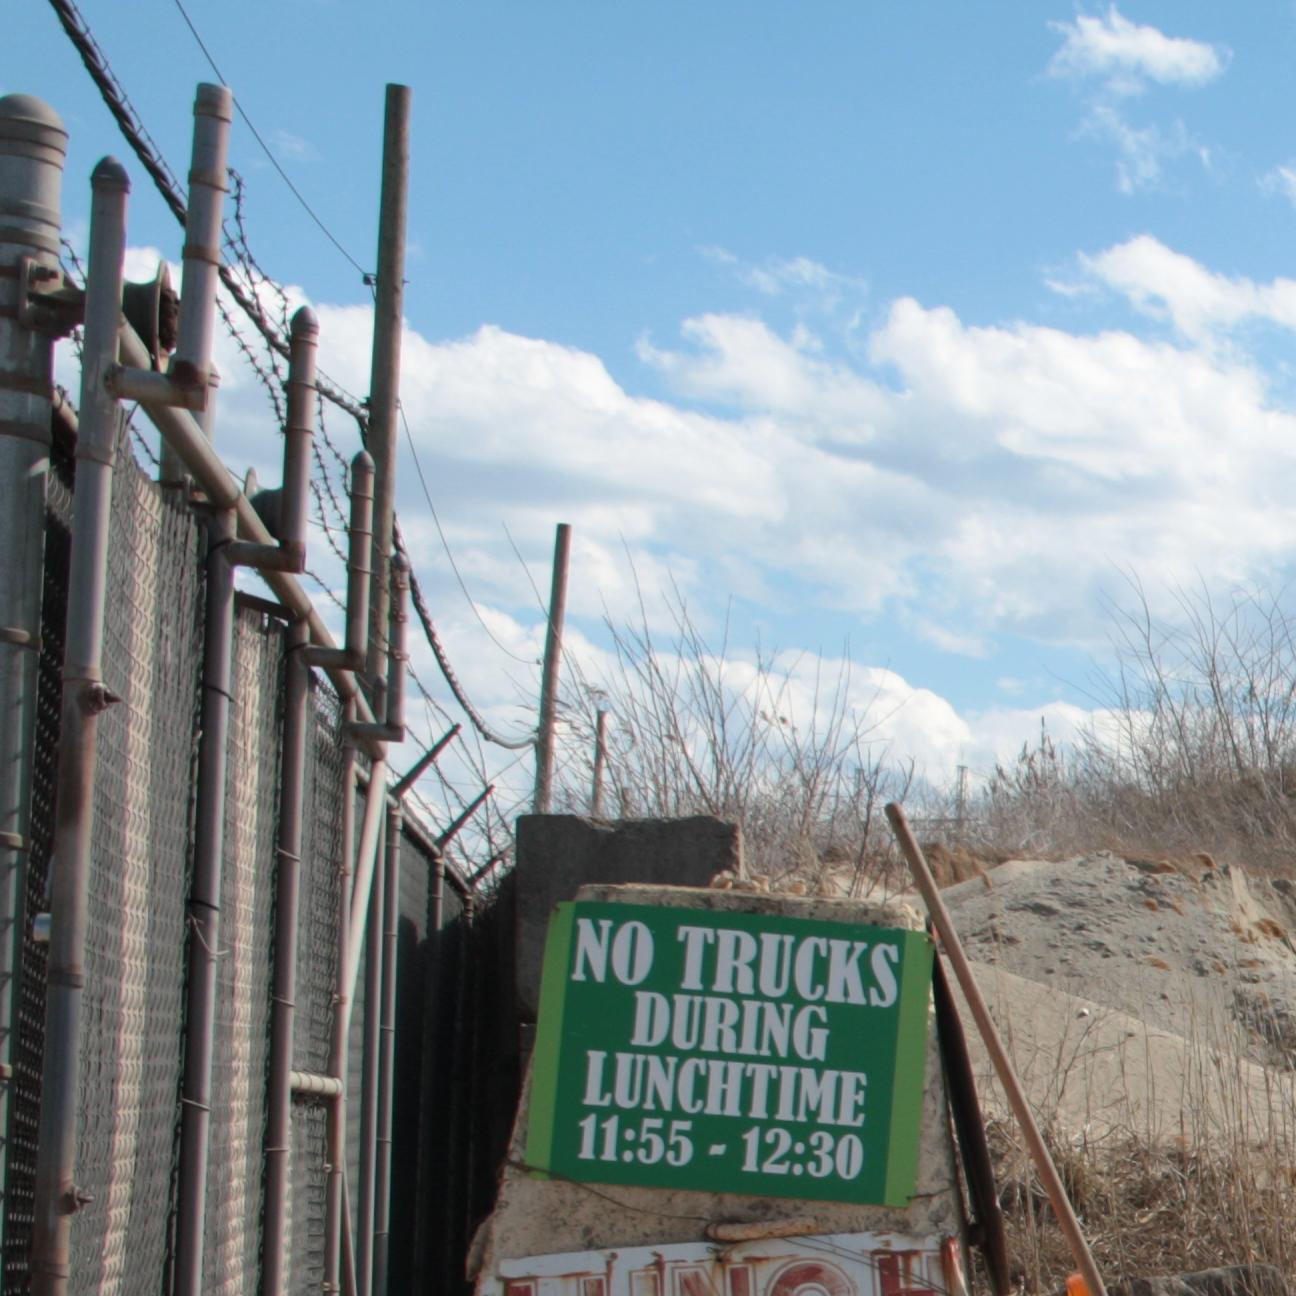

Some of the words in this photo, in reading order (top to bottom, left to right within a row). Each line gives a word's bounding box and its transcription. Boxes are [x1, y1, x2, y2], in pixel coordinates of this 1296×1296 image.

[571, 918, 654, 986] NO
[677, 925, 898, 1008] TRUCKS
[630, 991, 830, 1062] DURING
[583, 1051, 867, 1128] LUNCHTIME
[577, 1114, 694, 1167] 11:55
[741, 1127, 864, 1180] 12:30
